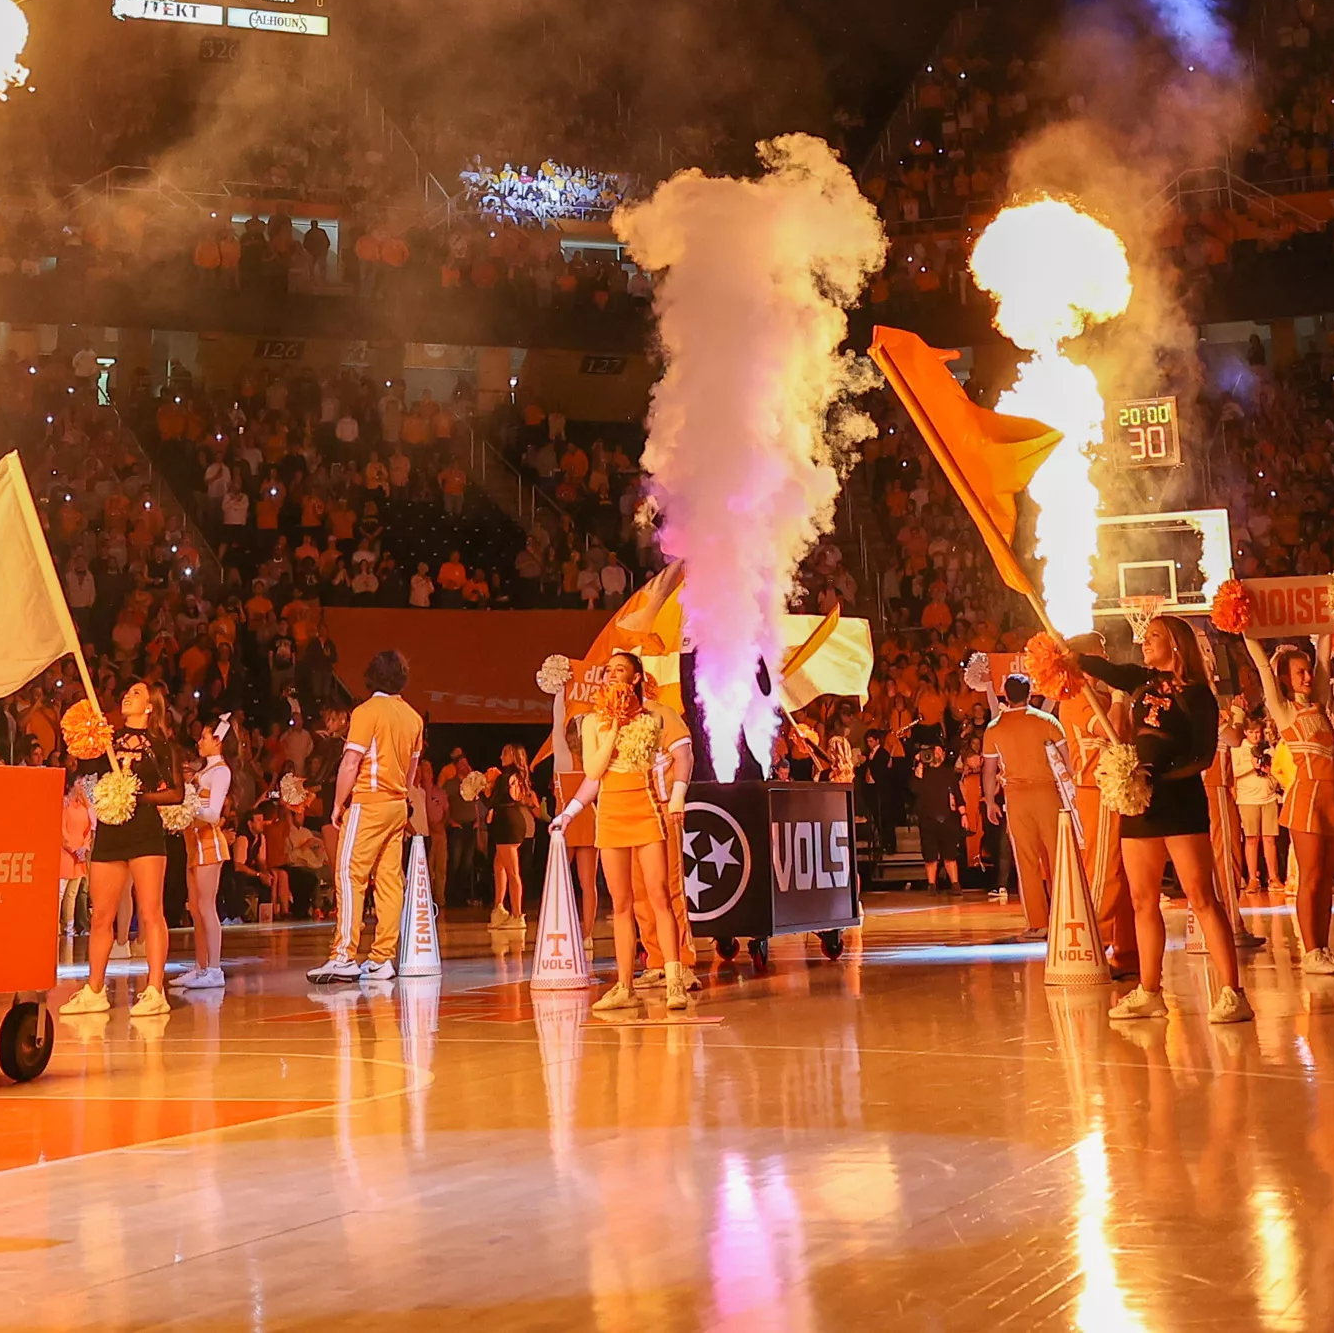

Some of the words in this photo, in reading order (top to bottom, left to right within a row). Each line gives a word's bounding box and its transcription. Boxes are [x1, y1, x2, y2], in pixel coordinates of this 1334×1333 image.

[249, 10, 308, 34] CALHOUN'S
[202, 40, 238, 59] 326
[262, 343, 298, 358] 126
[585, 359, 621, 374] 127
[1119, 404, 1169, 426] 20:00
[1129, 426, 1166, 460] 30
[1248, 586, 1330, 628] NOISE
[771, 820, 851, 892] VOLS
[415, 856, 432, 956] TENNESSEE
[546, 933, 567, 957] T
[1064, 922, 1086, 948] T
[541, 959, 573, 970] VOLS
[1058, 949, 1094, 962] VOLS
